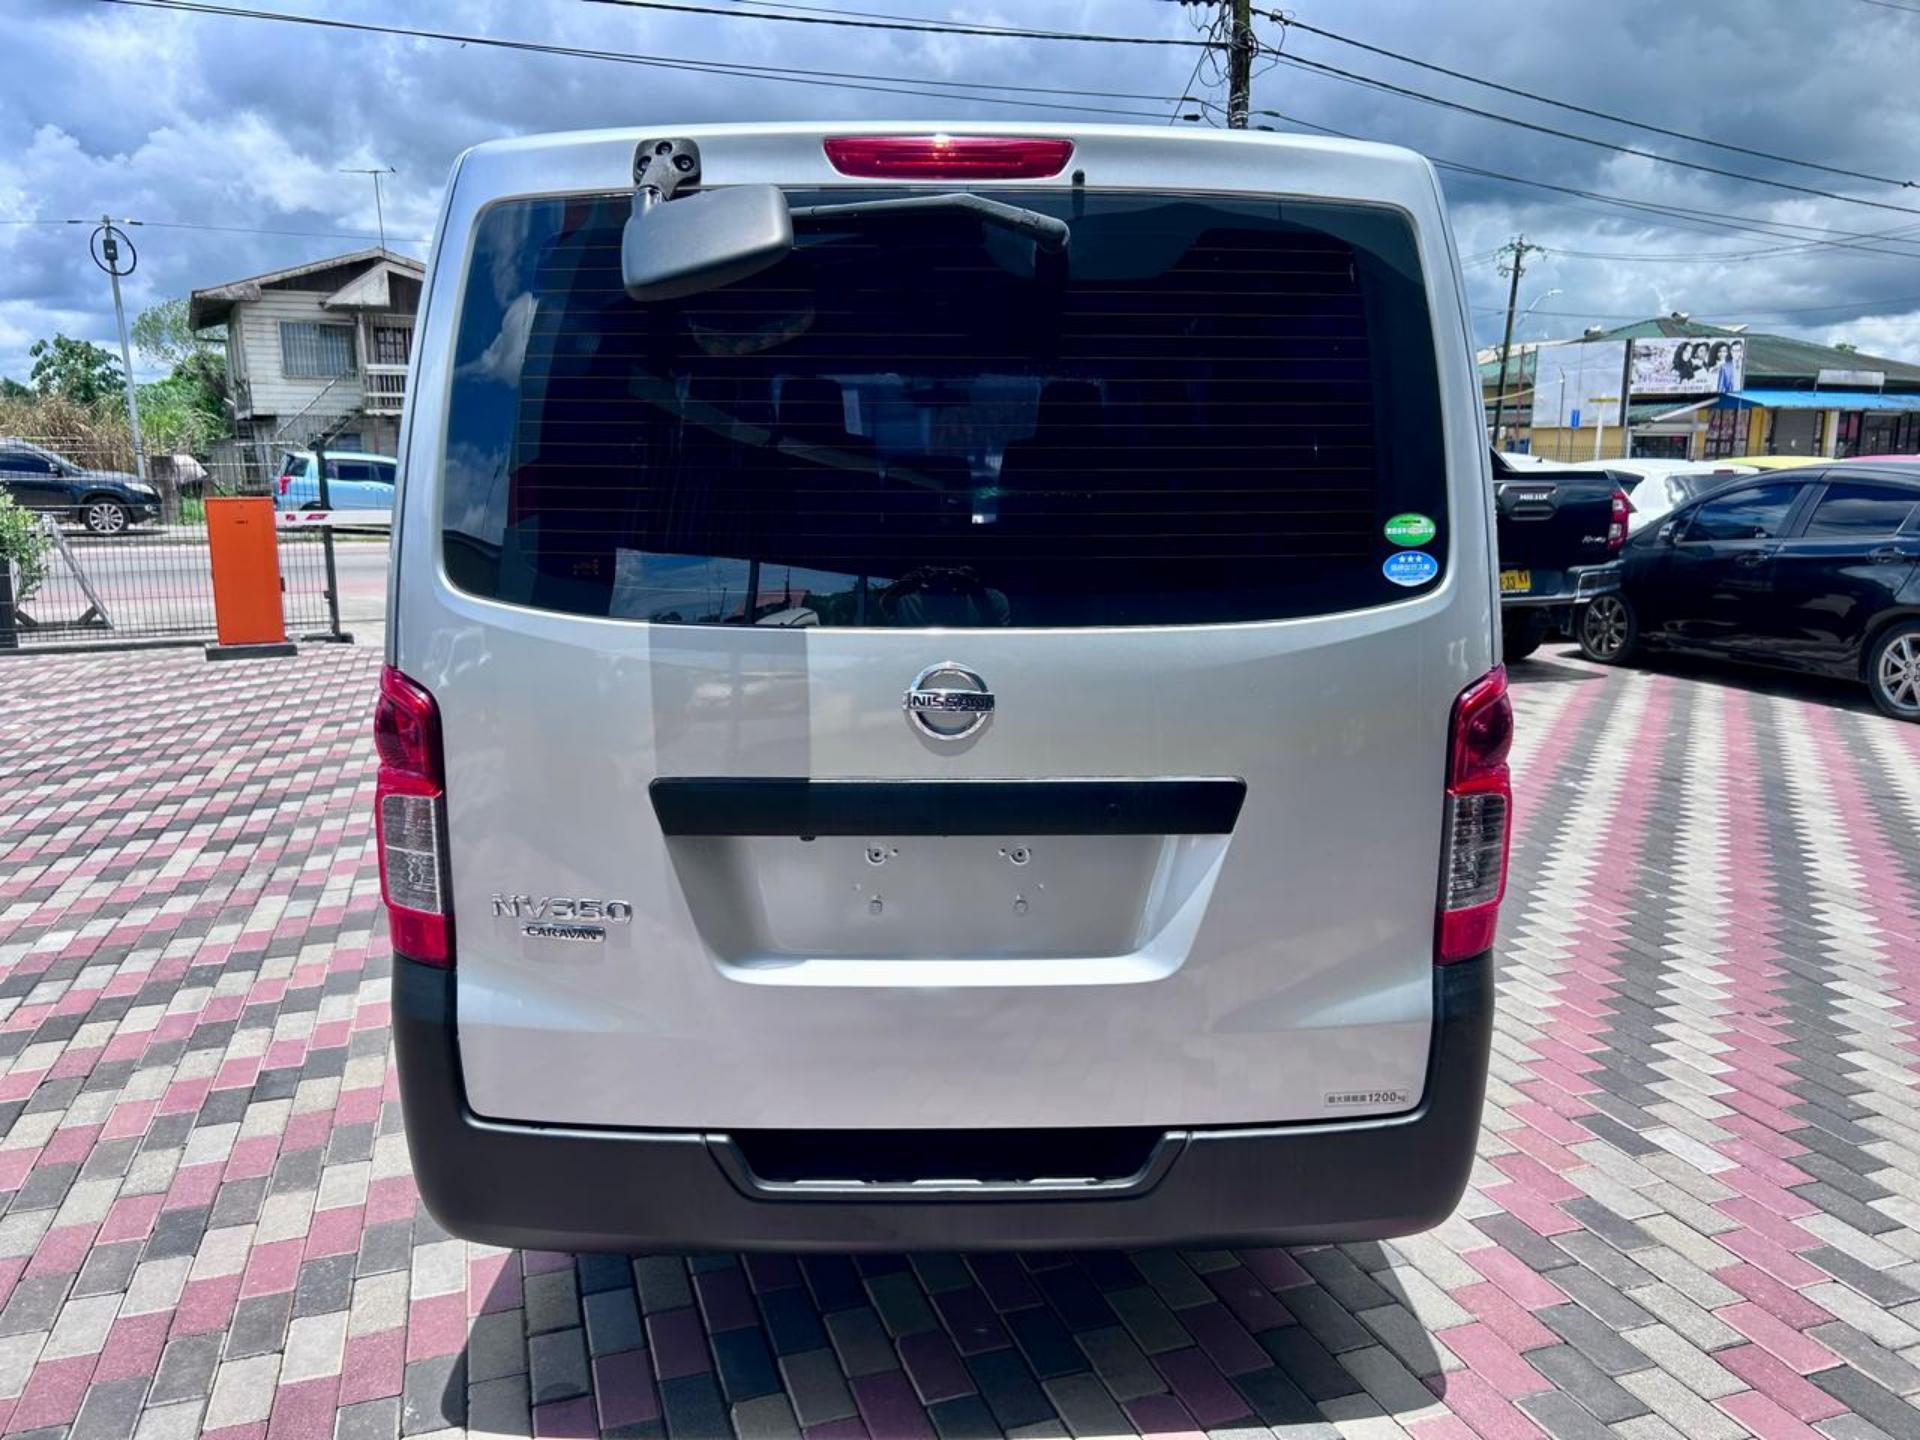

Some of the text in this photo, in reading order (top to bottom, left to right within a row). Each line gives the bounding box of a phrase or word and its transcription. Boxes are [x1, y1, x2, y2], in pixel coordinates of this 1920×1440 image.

[912, 695, 985, 708] NISSAN
[491, 893, 633, 925] NV350
[527, 925, 598, 941] CARAVAN
